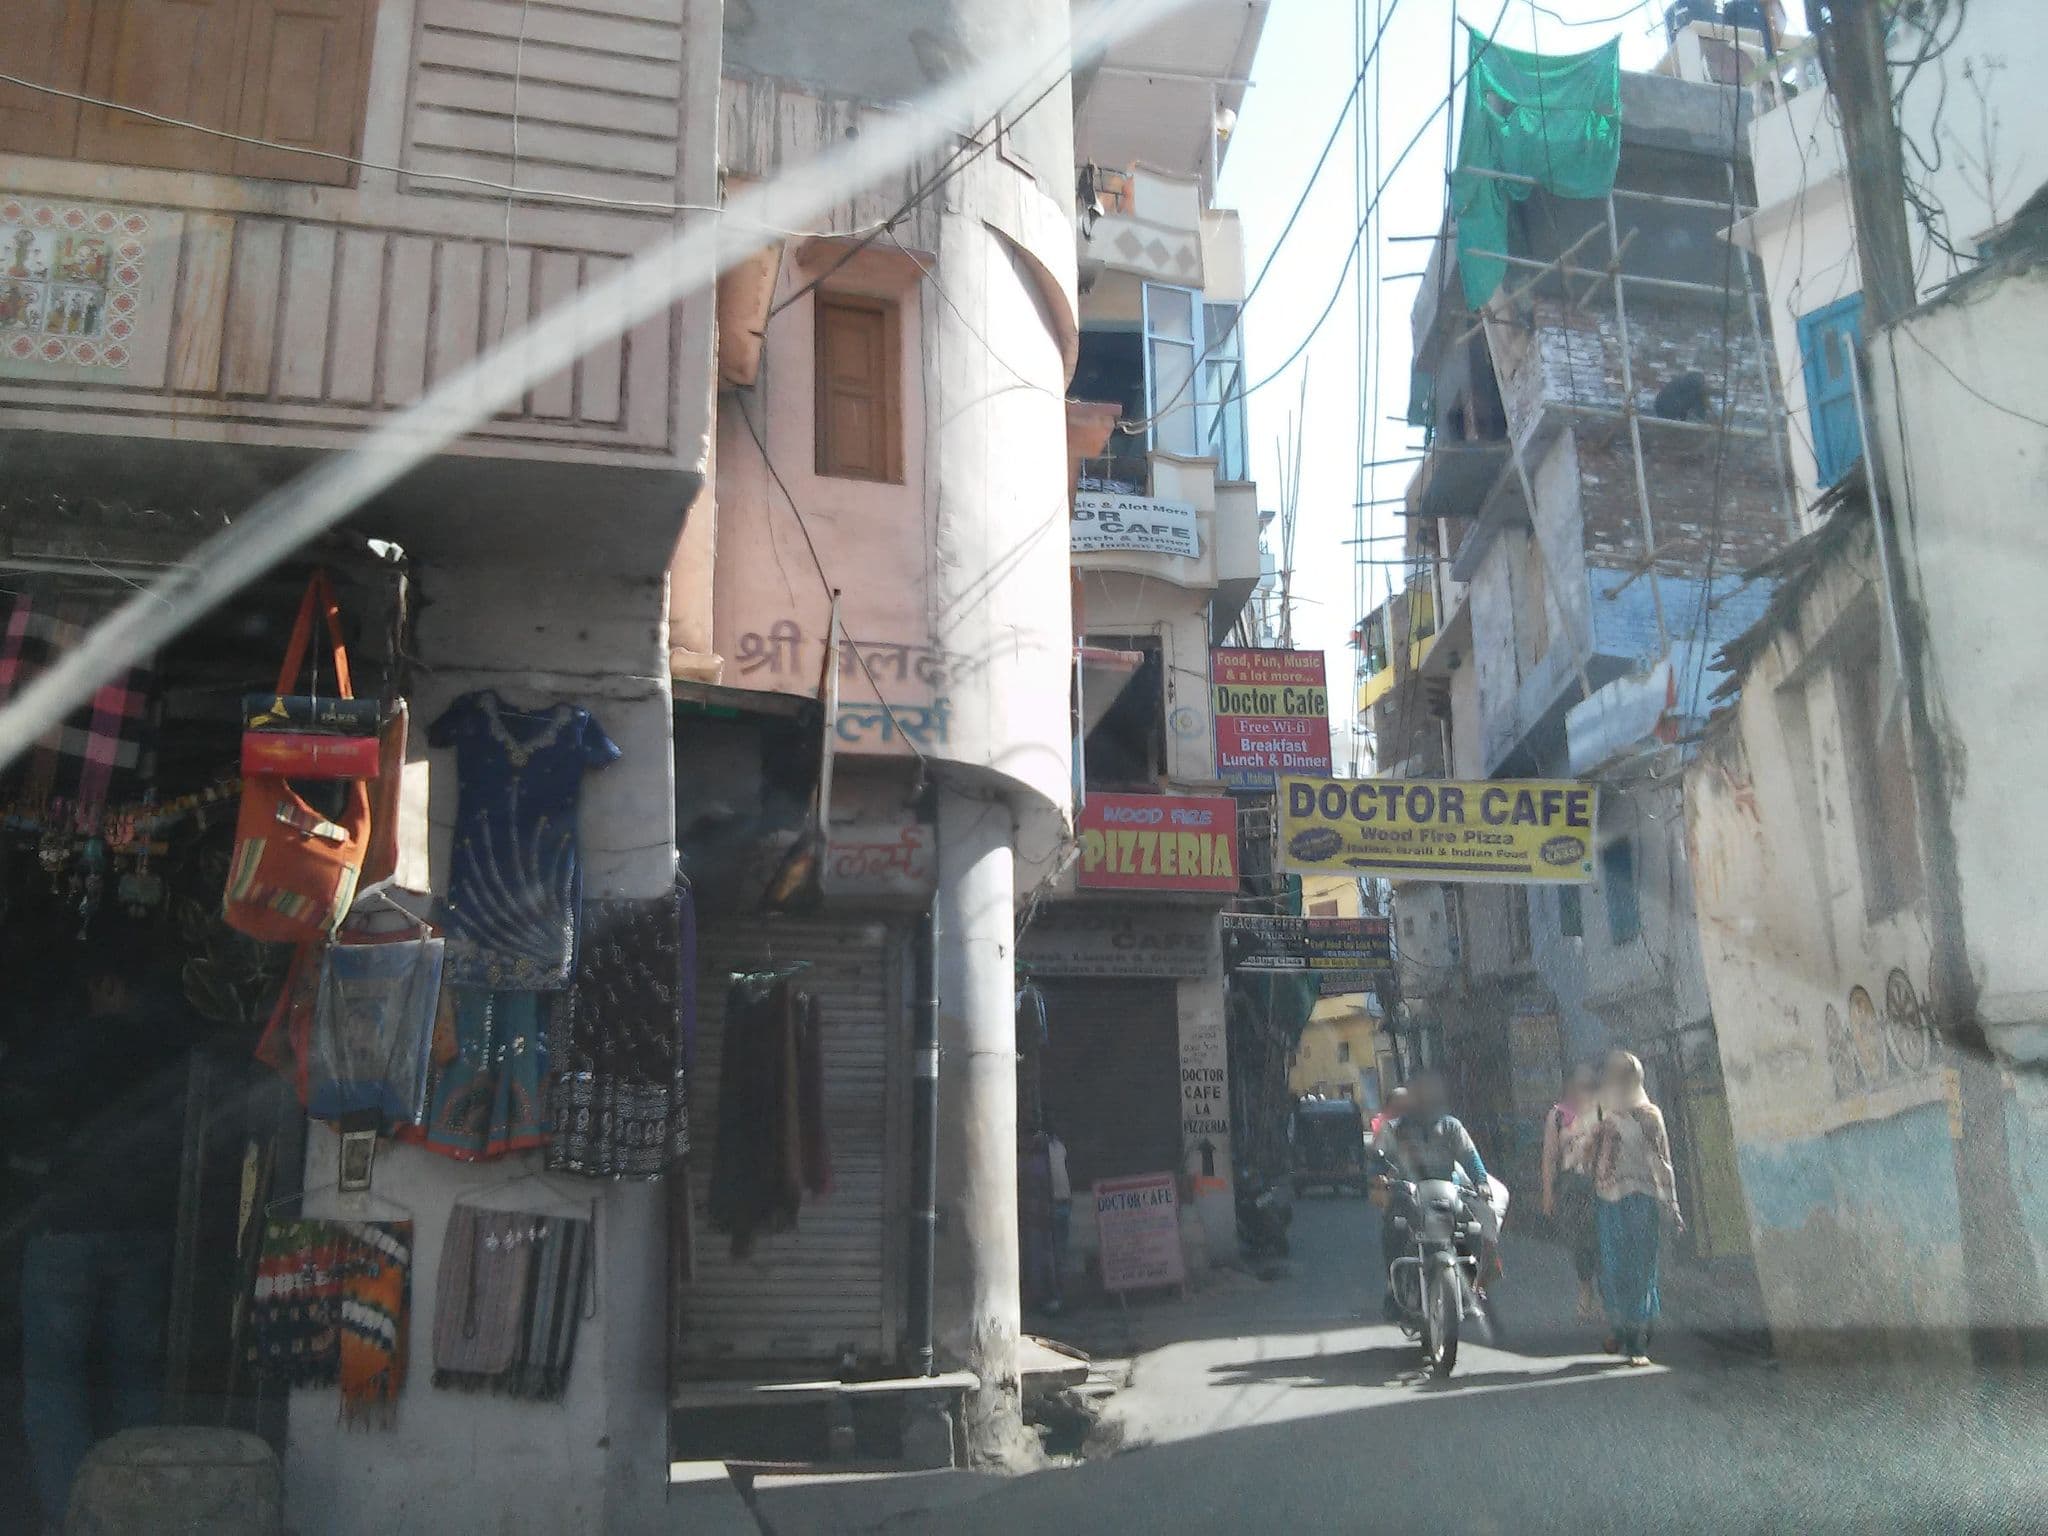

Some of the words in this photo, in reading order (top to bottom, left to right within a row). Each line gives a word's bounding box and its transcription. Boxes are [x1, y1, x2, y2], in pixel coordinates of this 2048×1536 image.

[1074, 510, 1121, 522] OR
[1118, 503, 1148, 511] Alot
[1153, 505, 1188, 516] More
[1100, 522, 1190, 540] CAFE
[735, 619, 802, 675] श्री
[1217, 652, 1251, 668] Food,
[1254, 654, 1281, 669] Fun,
[1285, 655, 1320, 668] Music
[1226, 669, 1236, 680] &
[1240, 672, 1247, 680] a
[1251, 671, 1267, 681] lot
[1218, 686, 1277, 714] Doctor
[1283, 687, 1324, 715] Cafe
[1240, 720, 1270, 733] Free
[1271, 720, 1306, 734] Wi-fi
[1241, 738, 1308, 753] Breakfast
[1222, 753, 1265, 767] Lunch
[1268, 753, 1279, 767] &
[1283, 754, 1328, 767] Dinner
[1290, 782, 1465, 824] DOCTOR
[1480, 788, 1589, 827] CAFE
[1103, 806, 1163, 824] WOOD
[1361, 826, 1413, 841] Wood
[1420, 829, 1457, 843] Fire
[1464, 830, 1514, 845] Pizza
[1083, 828, 1233, 877] PIZZERIA
[1438, 847, 1447, 857] &
[1452, 848, 1493, 858] Indian
[1497, 849, 1529, 859] Food
[1223, 916, 1258, 929] BLACK
[1182, 1068, 1224, 1081] DOCTOR
[1184, 1085, 1221, 1099] CAFE
[1195, 1103, 1210, 1115] LA
[1098, 1191, 1141, 1212] DOCTOR
